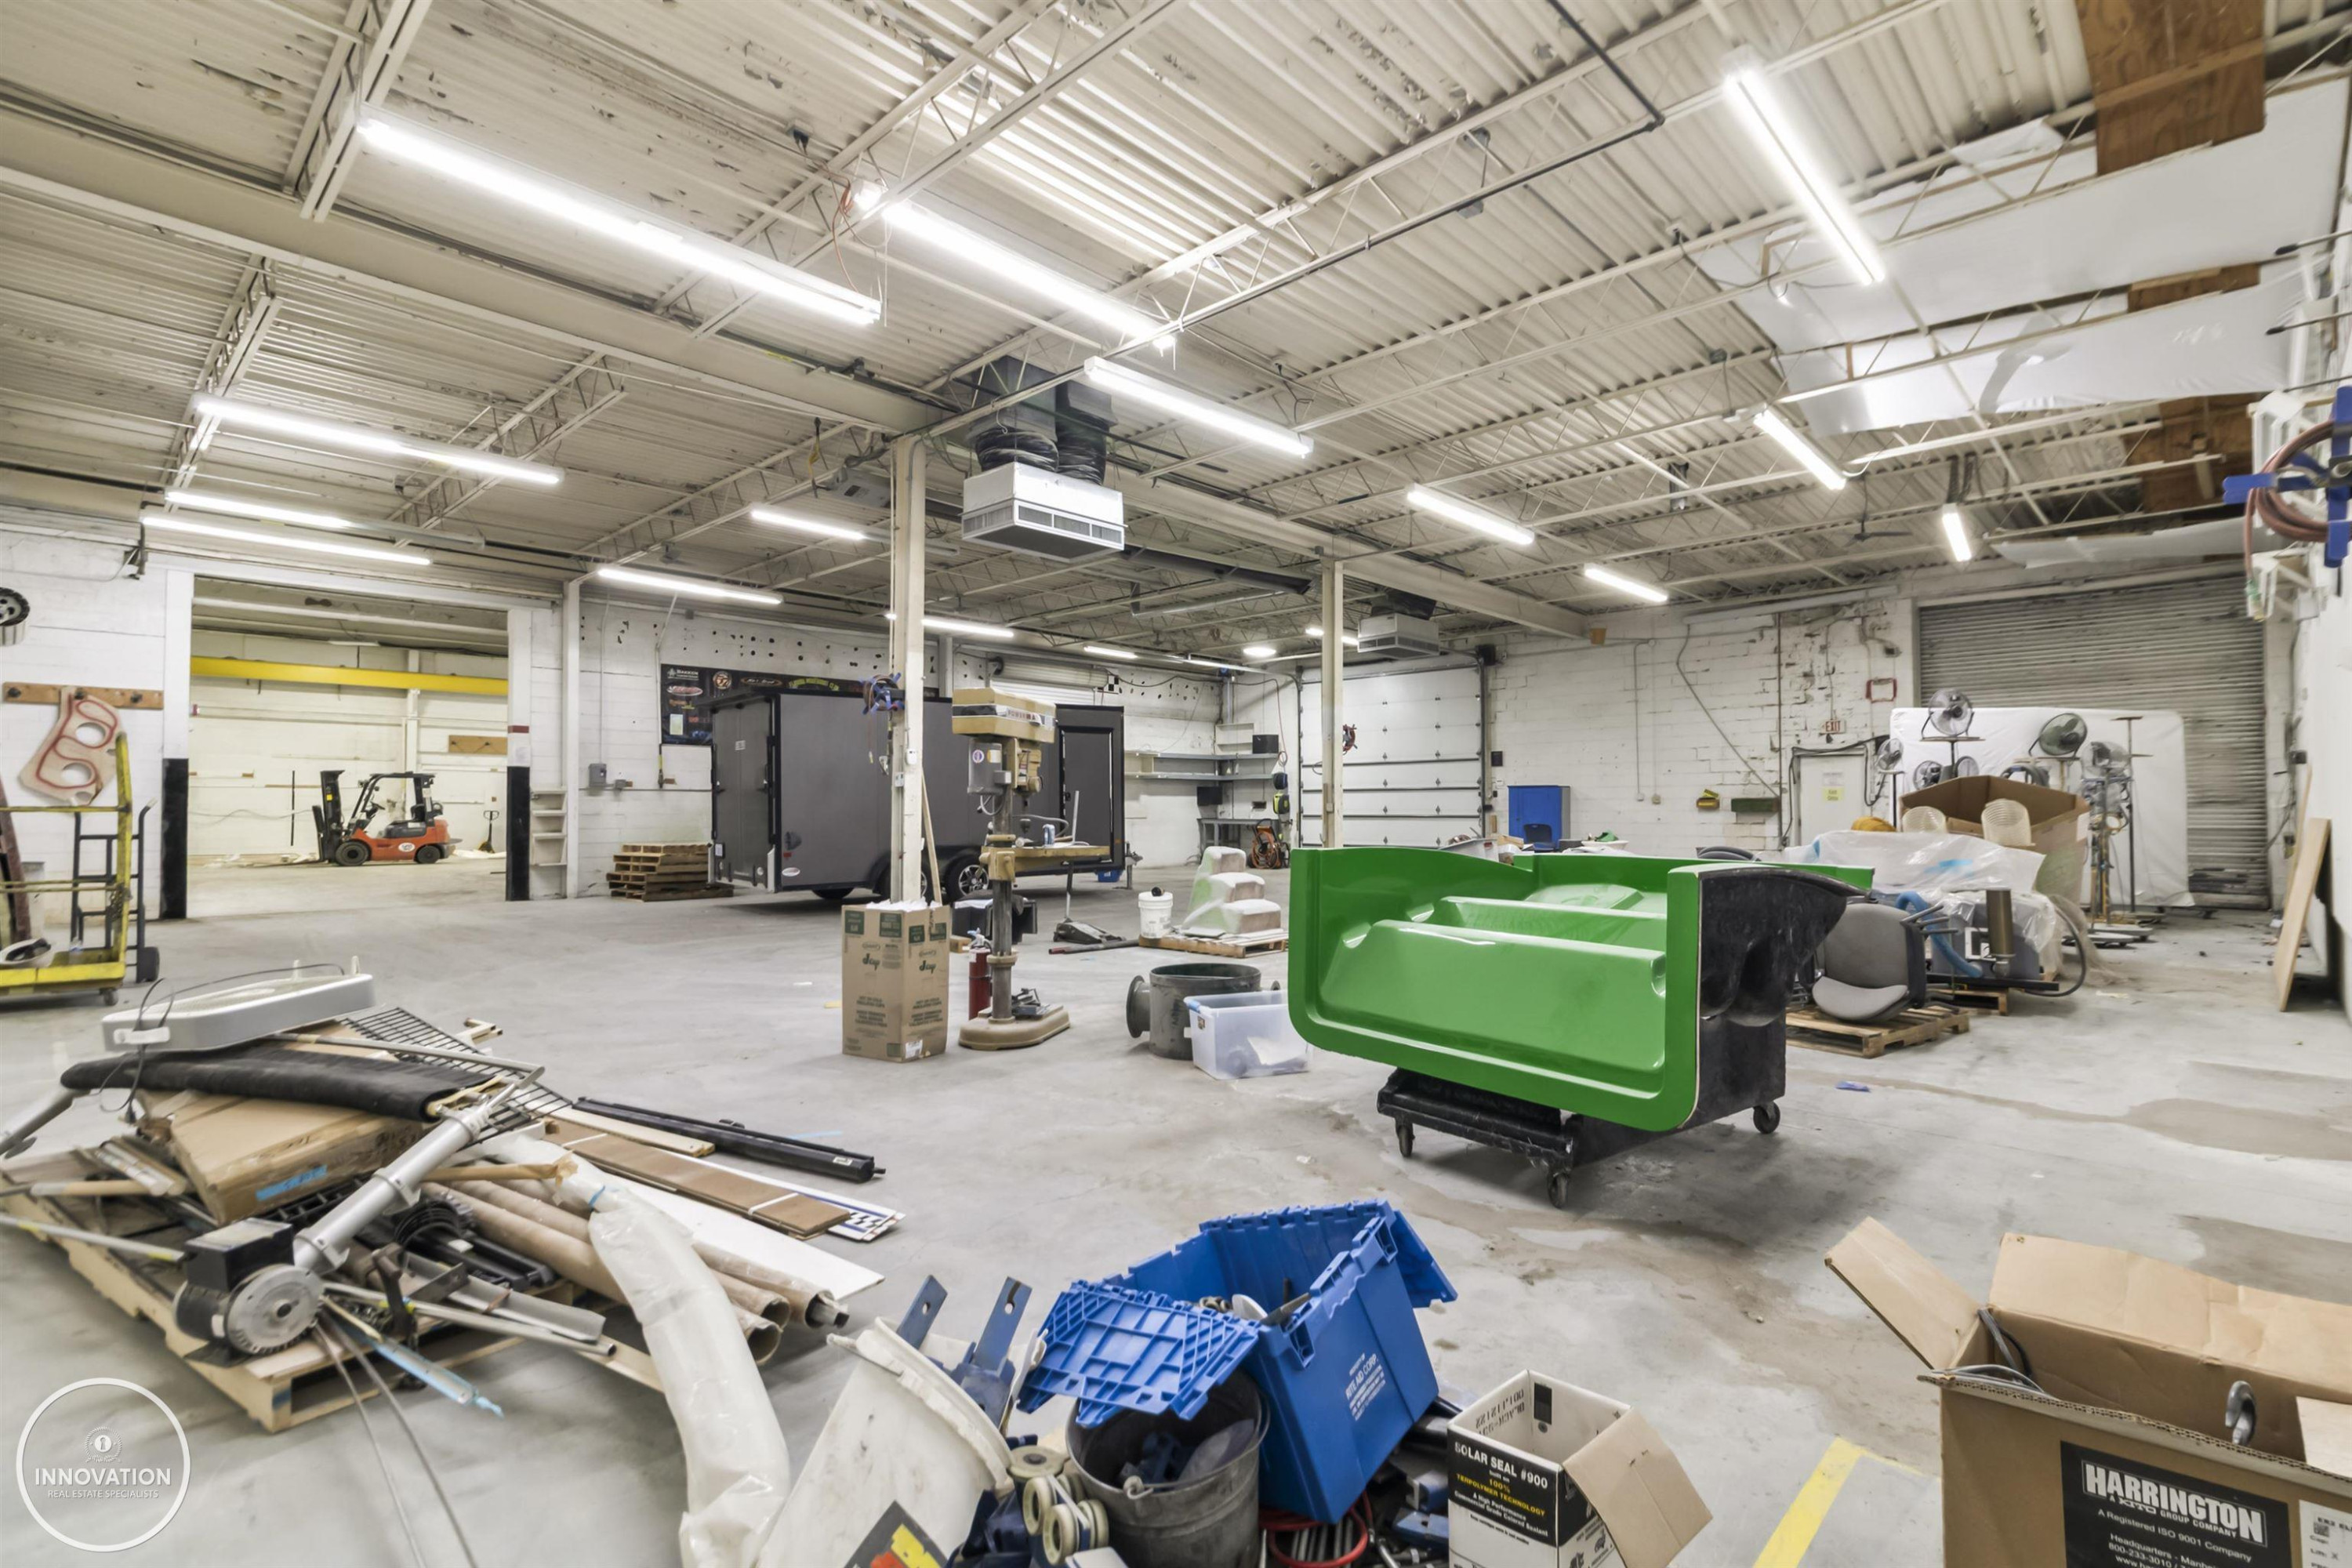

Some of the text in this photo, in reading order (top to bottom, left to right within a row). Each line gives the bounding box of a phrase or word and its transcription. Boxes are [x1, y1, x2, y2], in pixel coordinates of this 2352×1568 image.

[1825, 720, 1840, 732] EXIT
[1345, 1379, 1357, 1401] RITE
[1356, 1370, 1364, 1386] AID
[1454, 1442, 1548, 1490] SOLAR SEAL #900
[1457, 1474, 1545, 1517] TERPOLYMER TECHNOLOGY
[1490, 1479, 1511, 1494] 100%
[2086, 1464, 2263, 1543] HARRINGTON
[2098, 1508, 2252, 1563] A Registered ISO 9001 Company
[2160, 1509, 2190, 1523] GROUP
[2193, 1519, 2237, 1538] COMPANY
[2108, 1542, 2172, 1568] 800-233-3010
[2110, 1533, 2172, 1559] Headquarters
